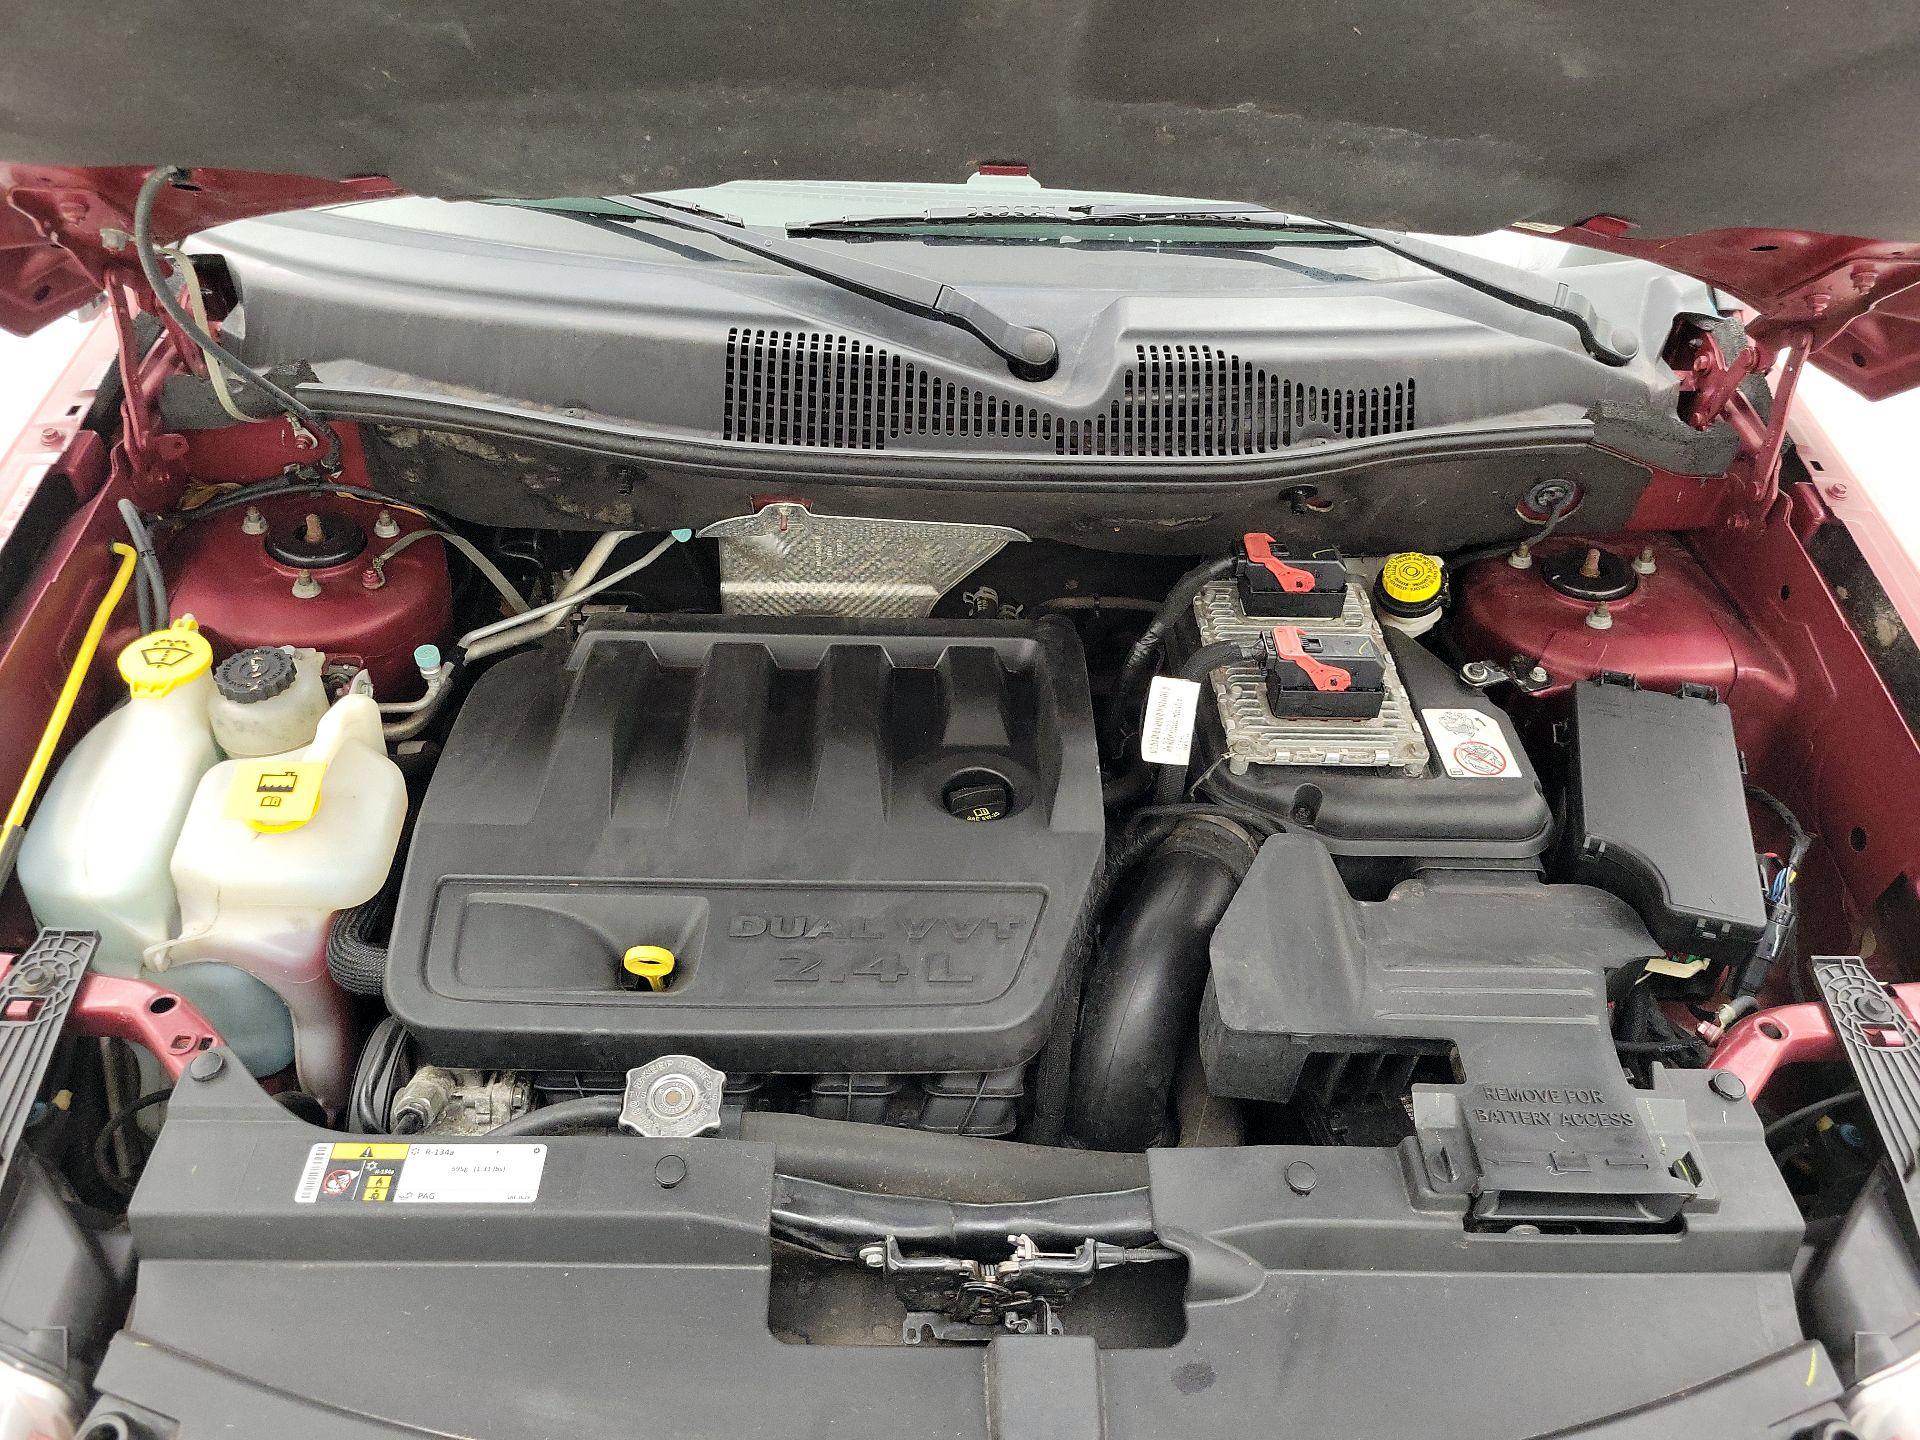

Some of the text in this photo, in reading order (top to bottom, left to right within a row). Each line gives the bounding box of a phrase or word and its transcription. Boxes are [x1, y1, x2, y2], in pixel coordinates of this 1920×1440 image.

[729, 915, 1026, 940] DUAL VVT
[773, 953, 974, 983] 2.4L
[1482, 1086, 1606, 1105] REMOVE FOR
[1475, 1108, 1635, 1128] BATTERY ACCESS
[417, 1192, 436, 1200] PAG
